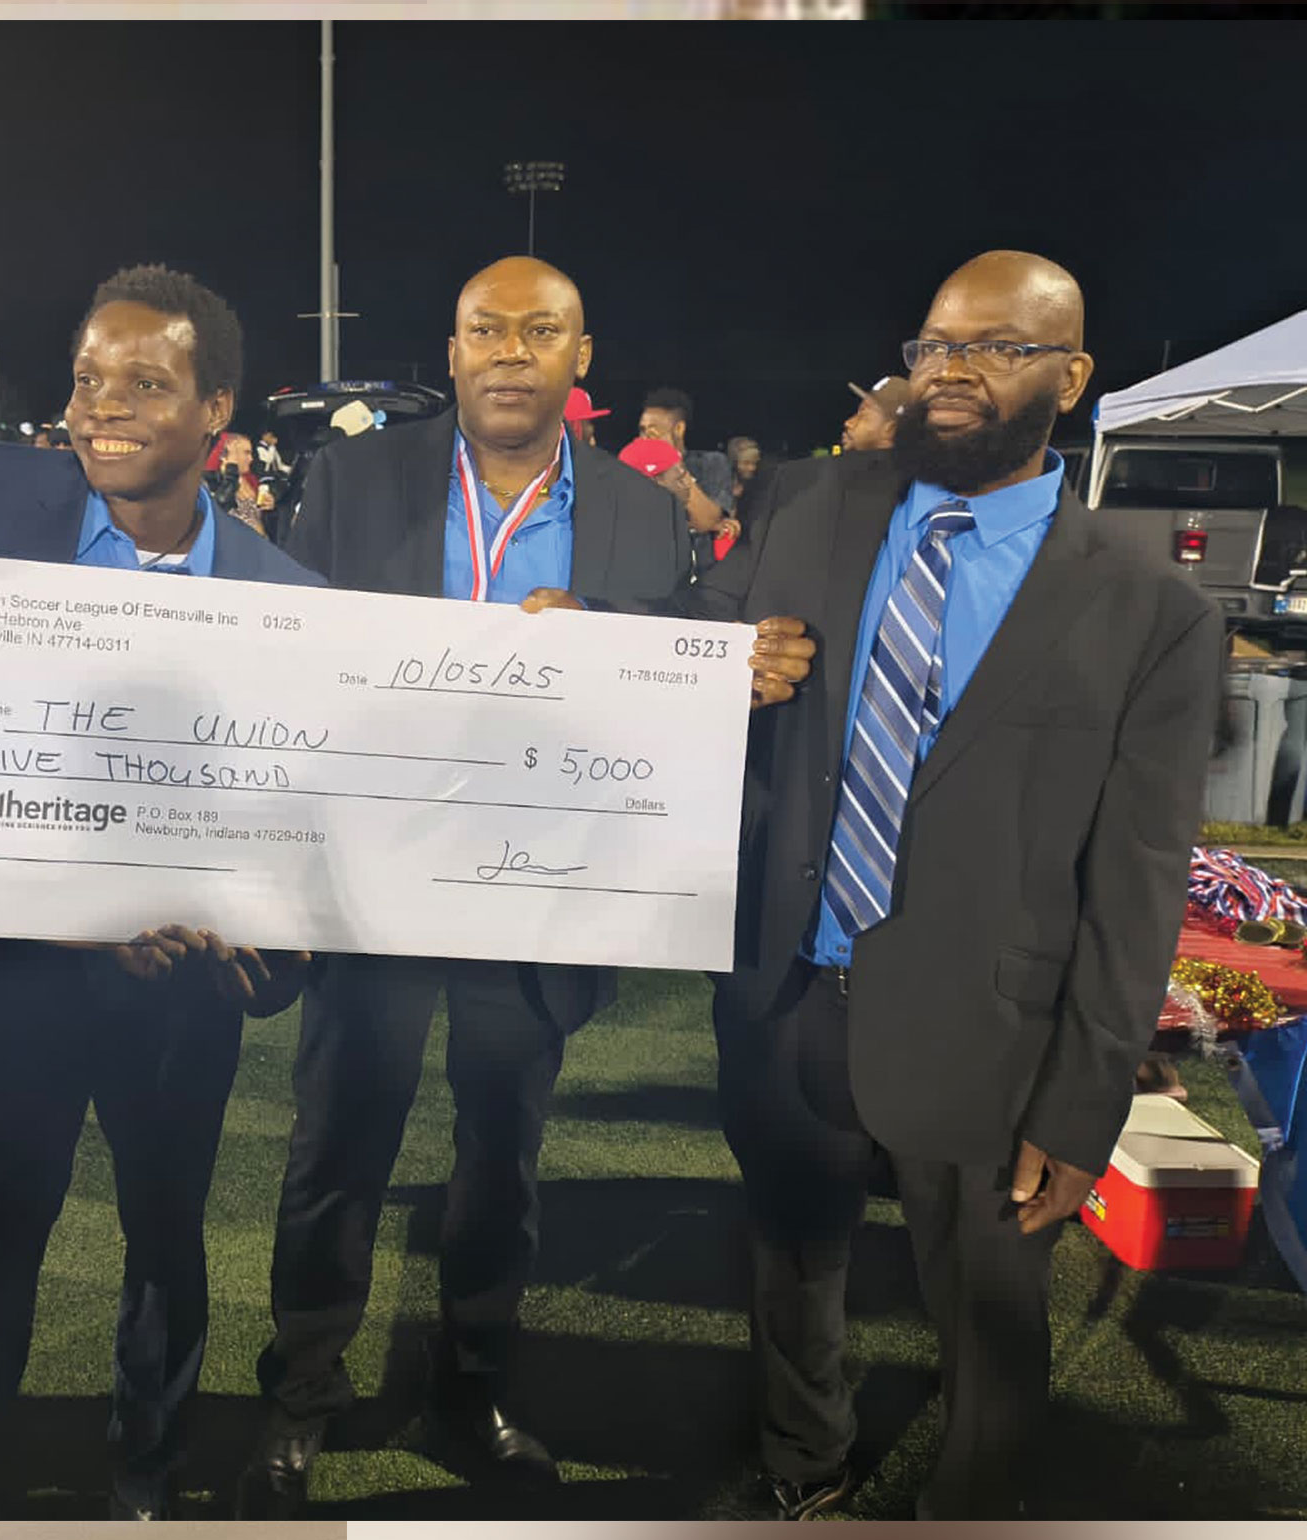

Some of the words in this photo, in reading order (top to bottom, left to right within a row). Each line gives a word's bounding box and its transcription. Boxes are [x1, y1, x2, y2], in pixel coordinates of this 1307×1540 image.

[10, 595, 60, 611] Soccer
[66, 600, 118, 617] League
[122, 602, 139, 616] Of
[143, 604, 213, 623] Evansville
[218, 613, 238, 626] Inc
[54, 617, 83, 631] Ave
[263, 614, 302, 632] 01/25
[27, 633, 42, 646] IN
[47, 635, 131, 651] 47714-0311
[674, 637, 729, 659] 0523
[389, 647, 564, 688] 10/05/25
[339, 671, 368, 686] Date
[35, 700, 135, 732] THE
[524, 746, 538, 769] $
[559, 747, 654, 785] 5,000
[7, 789, 127, 832] heritage
[137, 805, 164, 819] P.O.
[168, 808, 192, 822] Box
[198, 810, 219, 823] 189
[625, 797, 667, 812] Dollars
[135, 822, 202, 840] Newburgh,
[205, 828, 250, 841] Indiana
